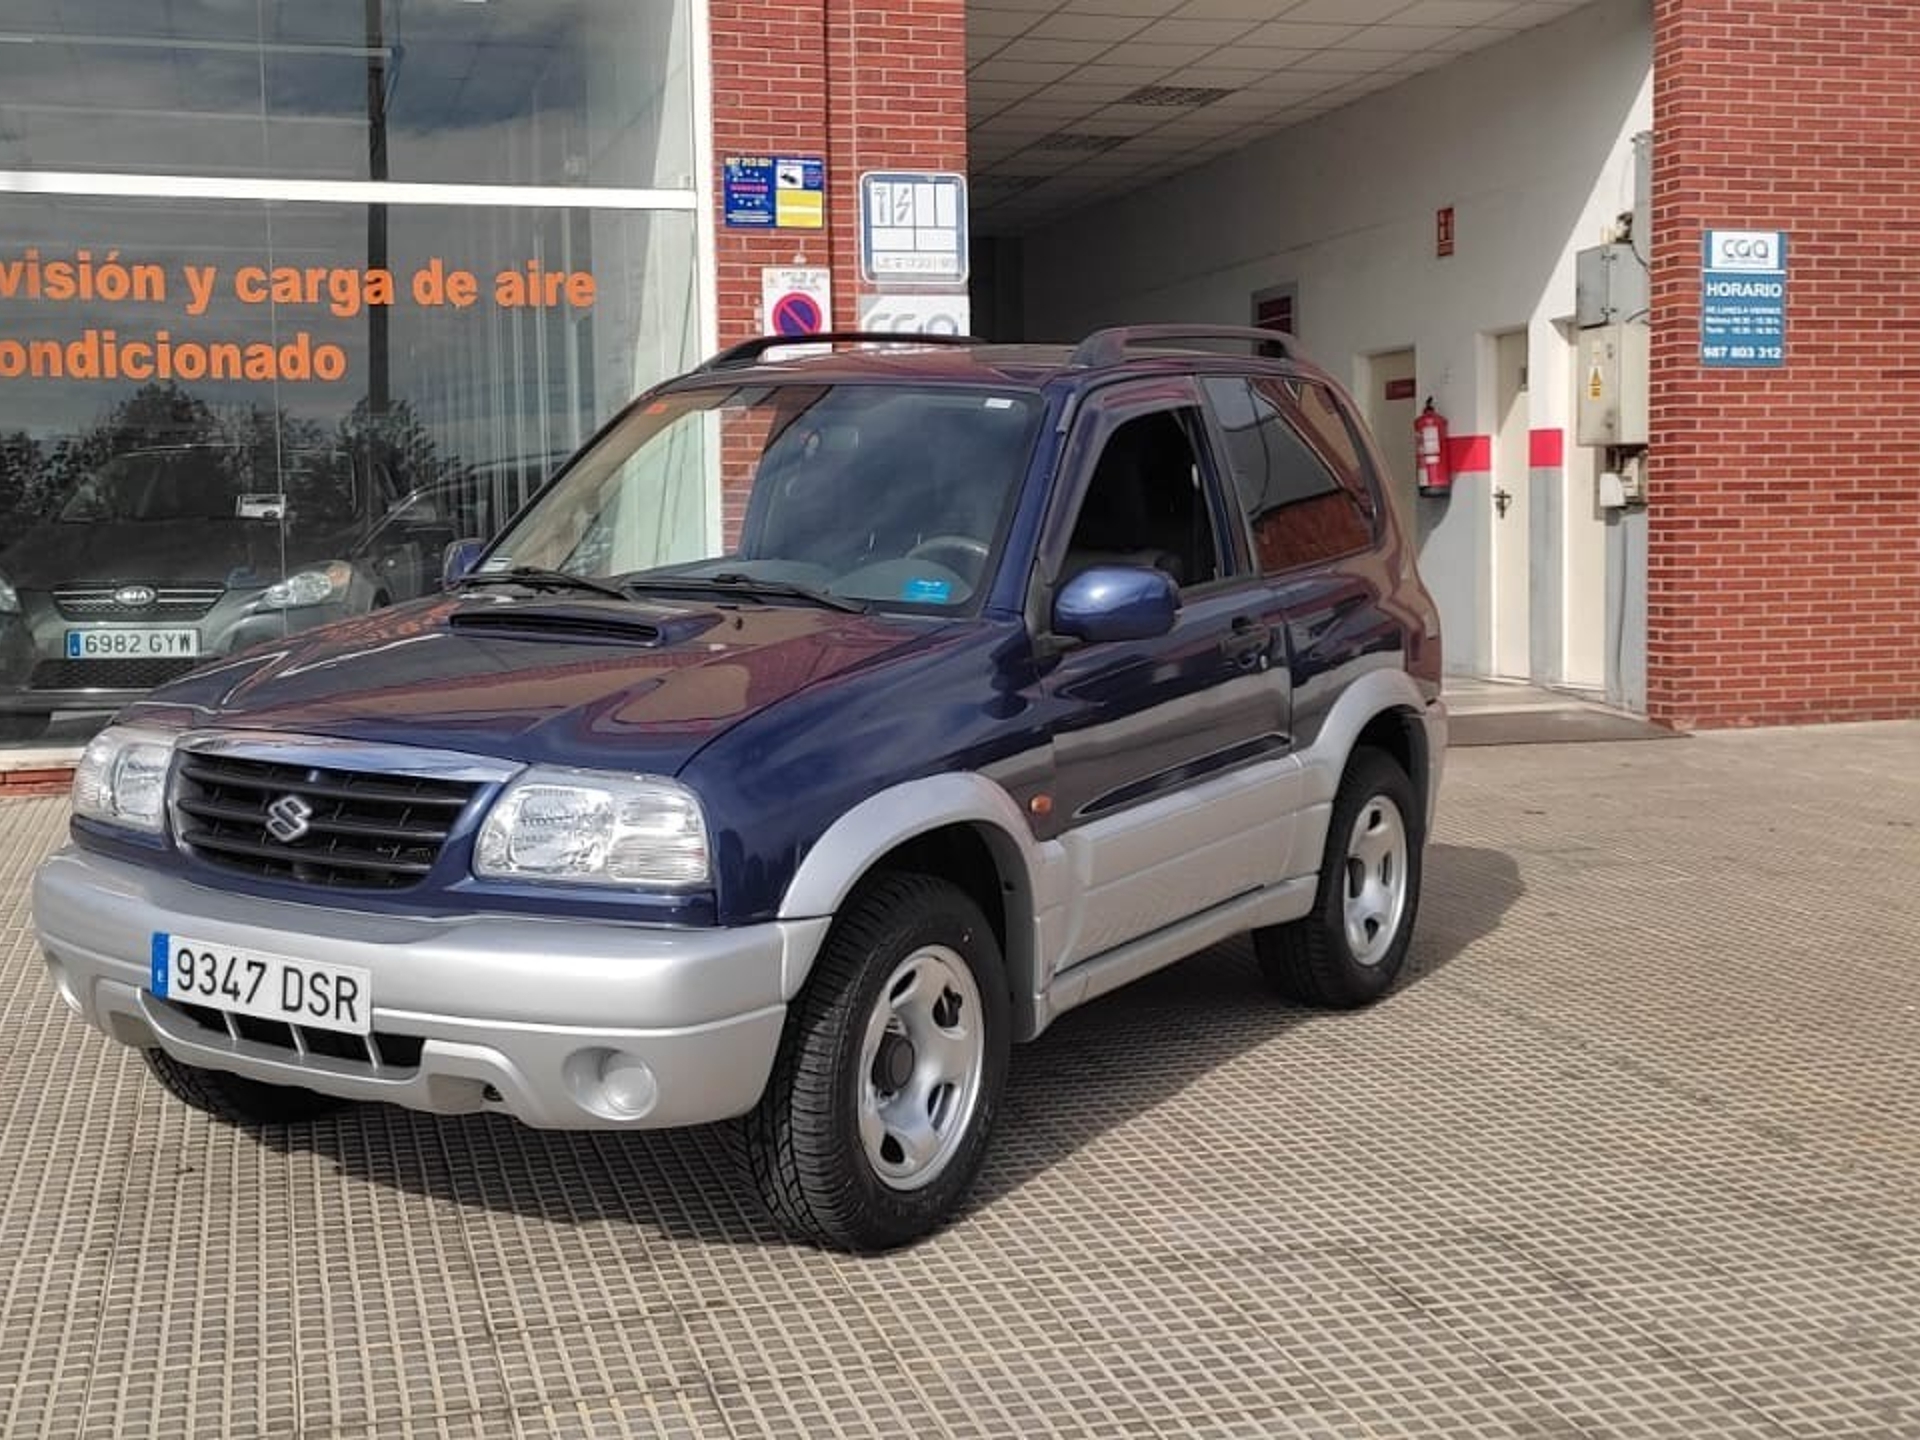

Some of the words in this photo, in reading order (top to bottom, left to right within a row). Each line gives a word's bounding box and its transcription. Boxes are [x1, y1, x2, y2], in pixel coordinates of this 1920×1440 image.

[184, 265, 216, 315] y
[235, 266, 395, 317] carga
[412, 256, 478, 306] de
[494, 258, 597, 307] aire
[1706, 282, 1782, 297] HORARIO
[1757, 346, 1782, 359] 312
[85, 634, 141, 653] 6982
[149, 634, 191, 653] GYW
[177, 947, 267, 1005] 9347
[281, 965, 358, 1022] DSR
